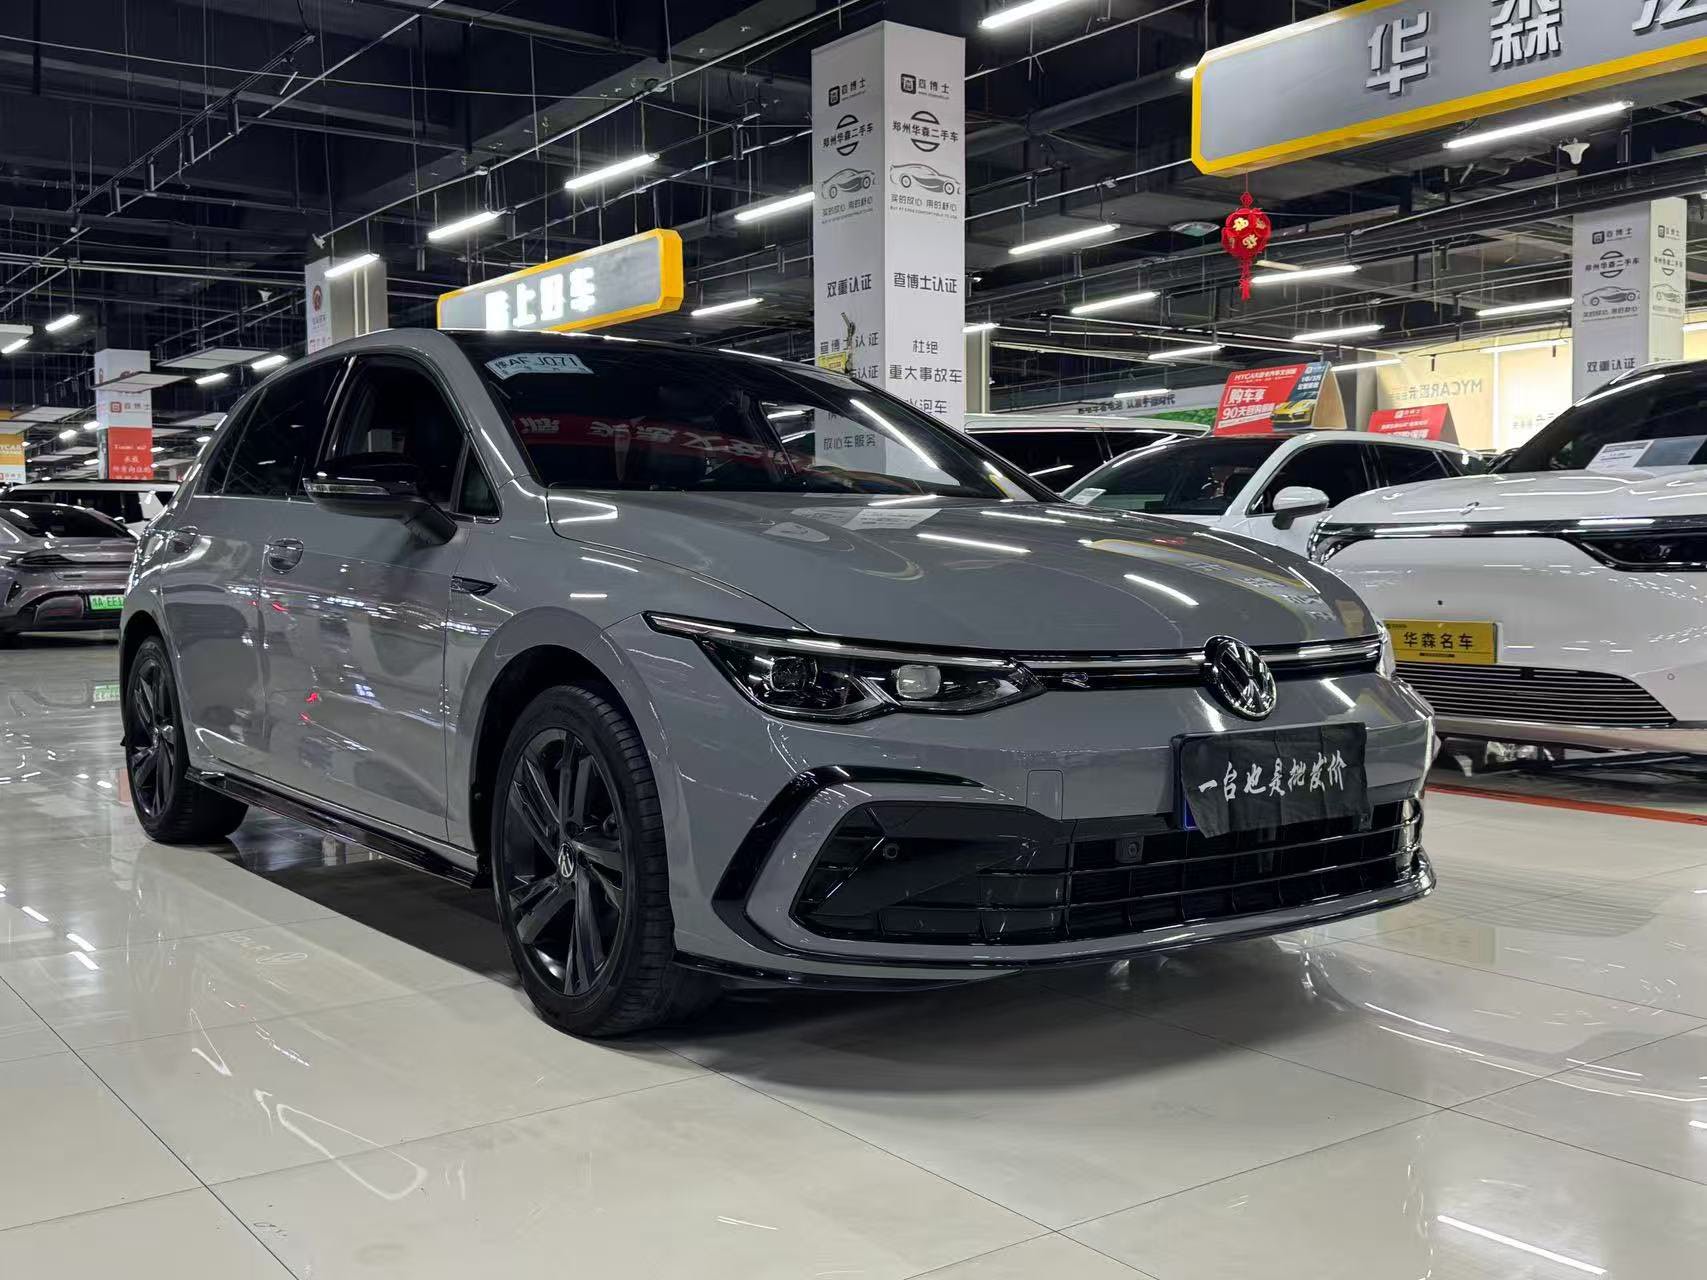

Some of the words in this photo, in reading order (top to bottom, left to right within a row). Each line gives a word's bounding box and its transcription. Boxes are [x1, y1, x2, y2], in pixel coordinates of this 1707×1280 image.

[823, 122, 873, 148] 郑州华森二手车
[892, 121, 959, 142] 郑州华森二手车
[826, 273, 872, 298] 双重认证
[893, 272, 957, 294] 查博士认证
[913, 339, 938, 355] 杜绝
[889, 364, 962, 384] 重大事故车
[823, 434, 876, 451] 放心车服务
[1404, 632, 1473, 650] 华森名车
[1198, 750, 1347, 802] 一台也是批发价
